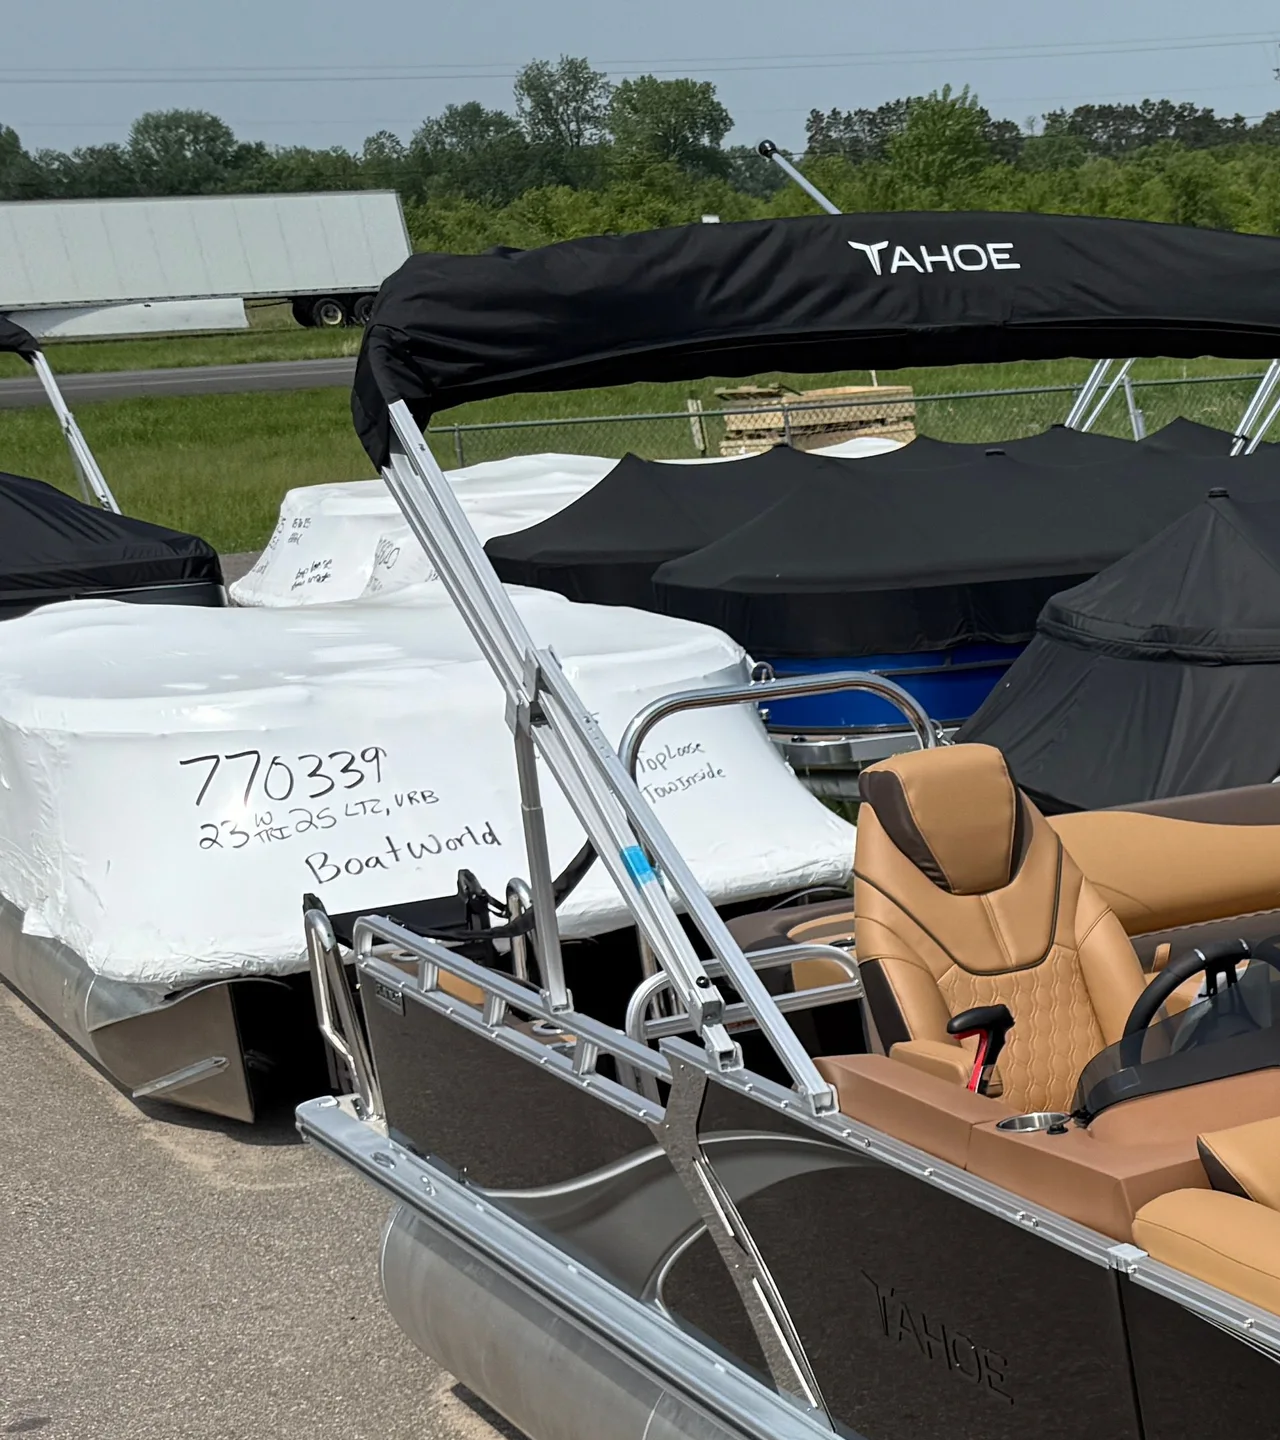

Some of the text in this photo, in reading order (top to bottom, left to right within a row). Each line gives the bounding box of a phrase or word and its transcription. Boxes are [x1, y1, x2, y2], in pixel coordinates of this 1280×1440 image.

[847, 240, 1021, 276] TAHOE
[179, 746, 388, 807] 770339
[198, 819, 251, 850] 23
[860, 1268, 1015, 1406] TAHOE
